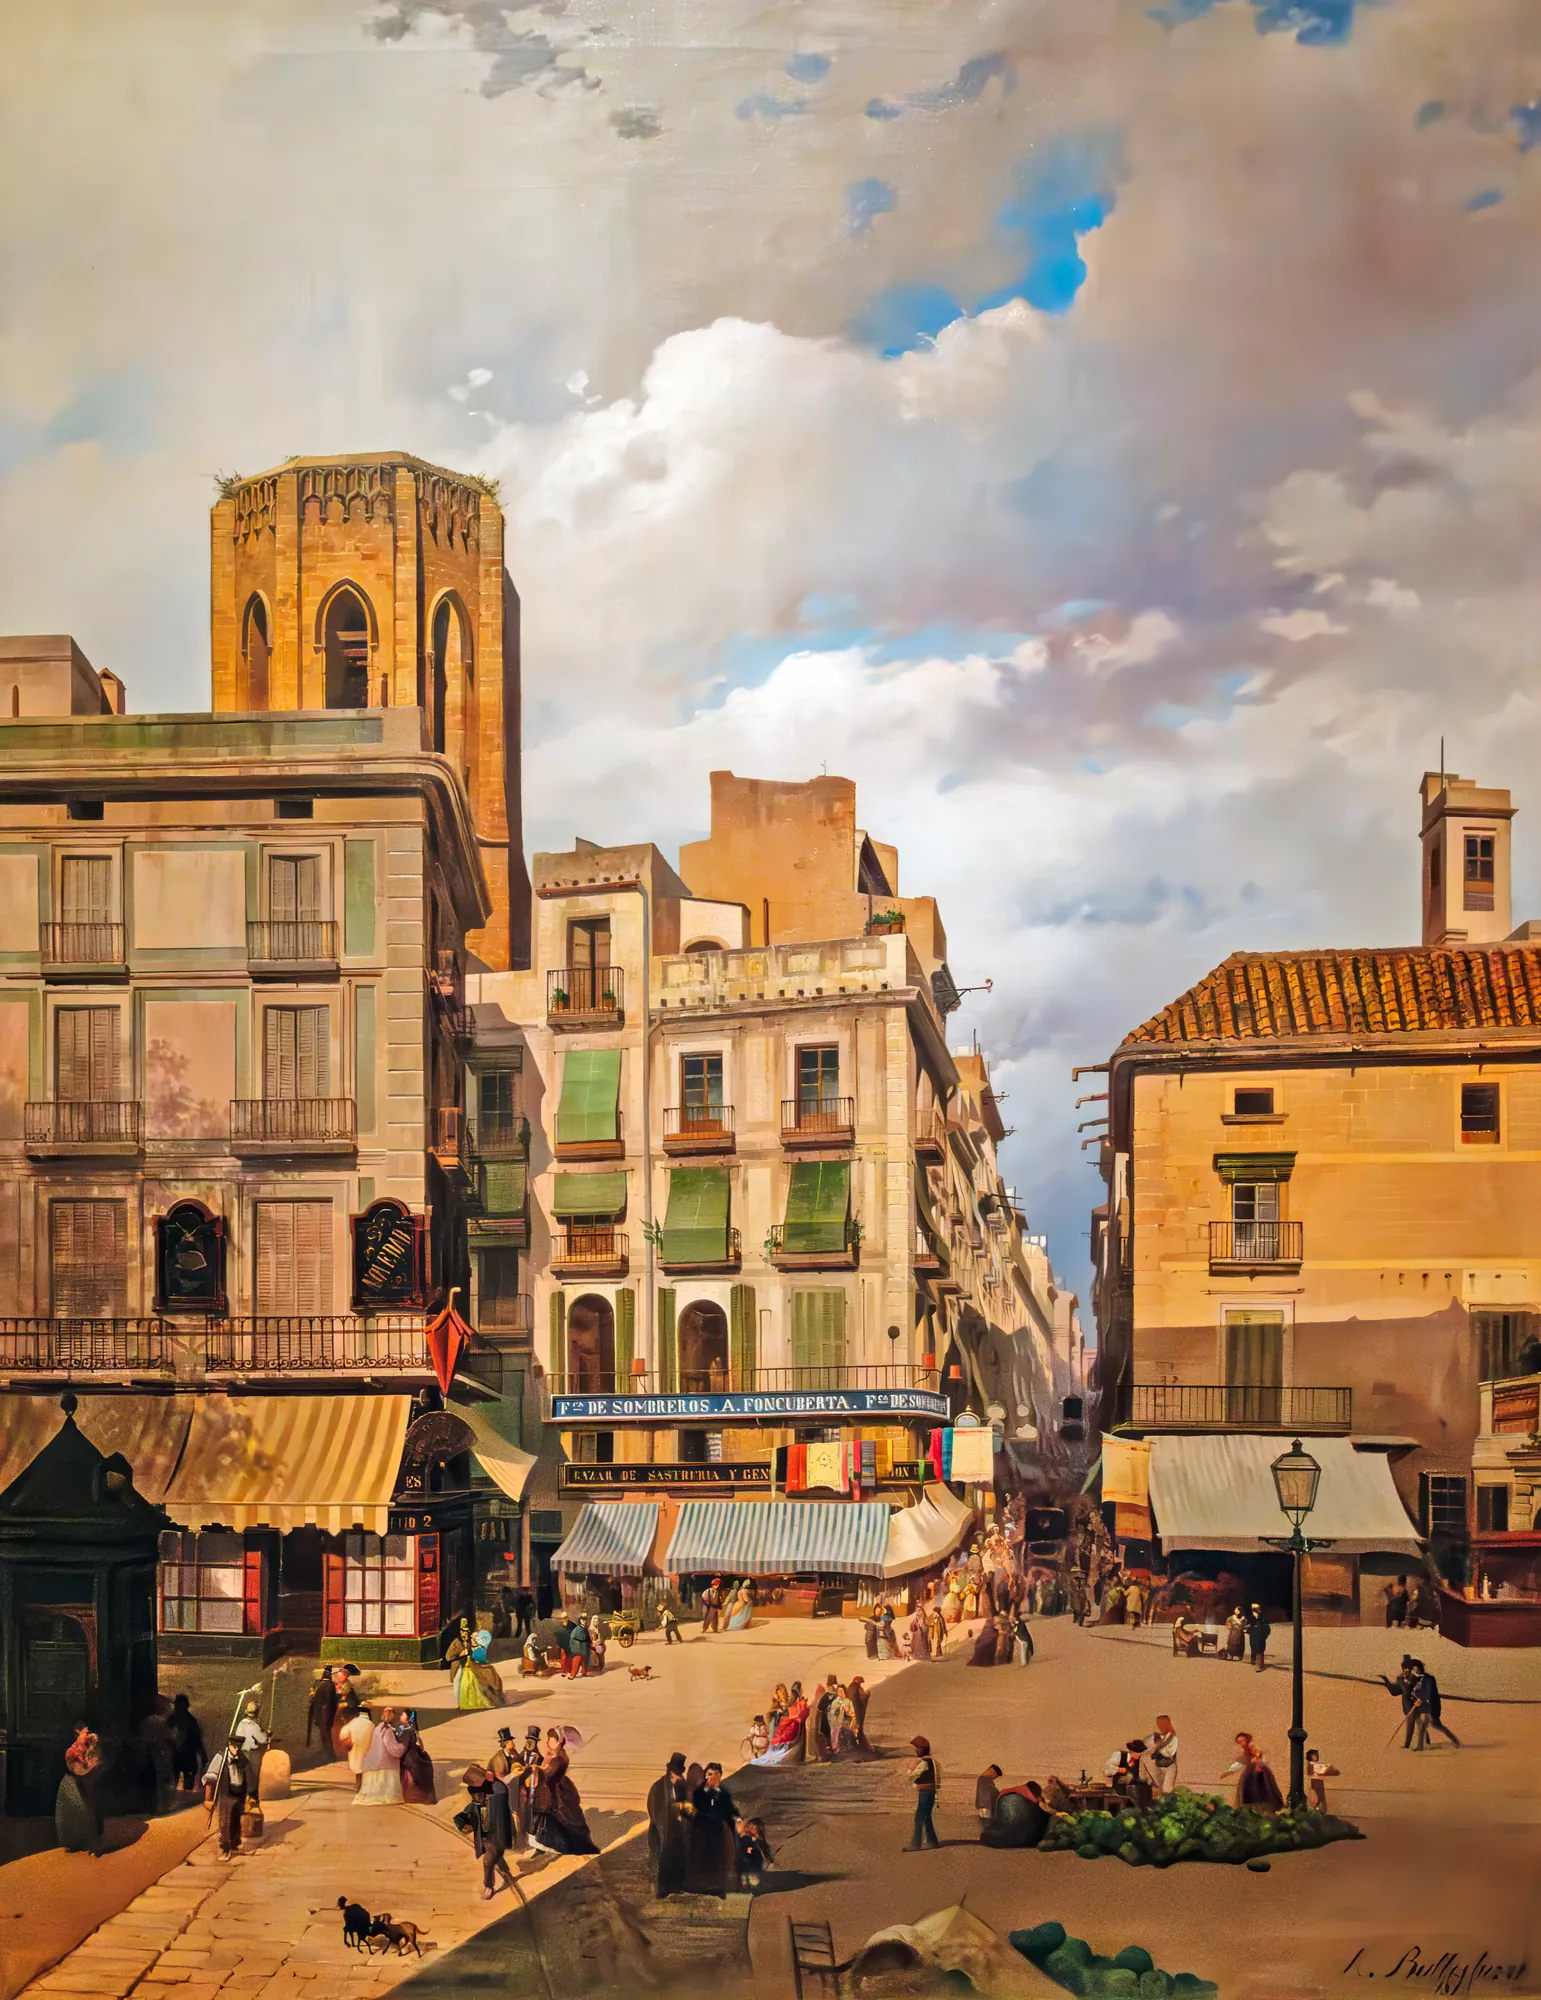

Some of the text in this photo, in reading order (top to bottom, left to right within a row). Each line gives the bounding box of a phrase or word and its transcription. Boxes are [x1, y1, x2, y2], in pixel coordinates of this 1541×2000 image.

[587, 1400, 607, 1415] DE
[890, 1394, 908, 1409] DE
[728, 1468, 737, 1481] Y
[423, 1515, 432, 1527] 2
